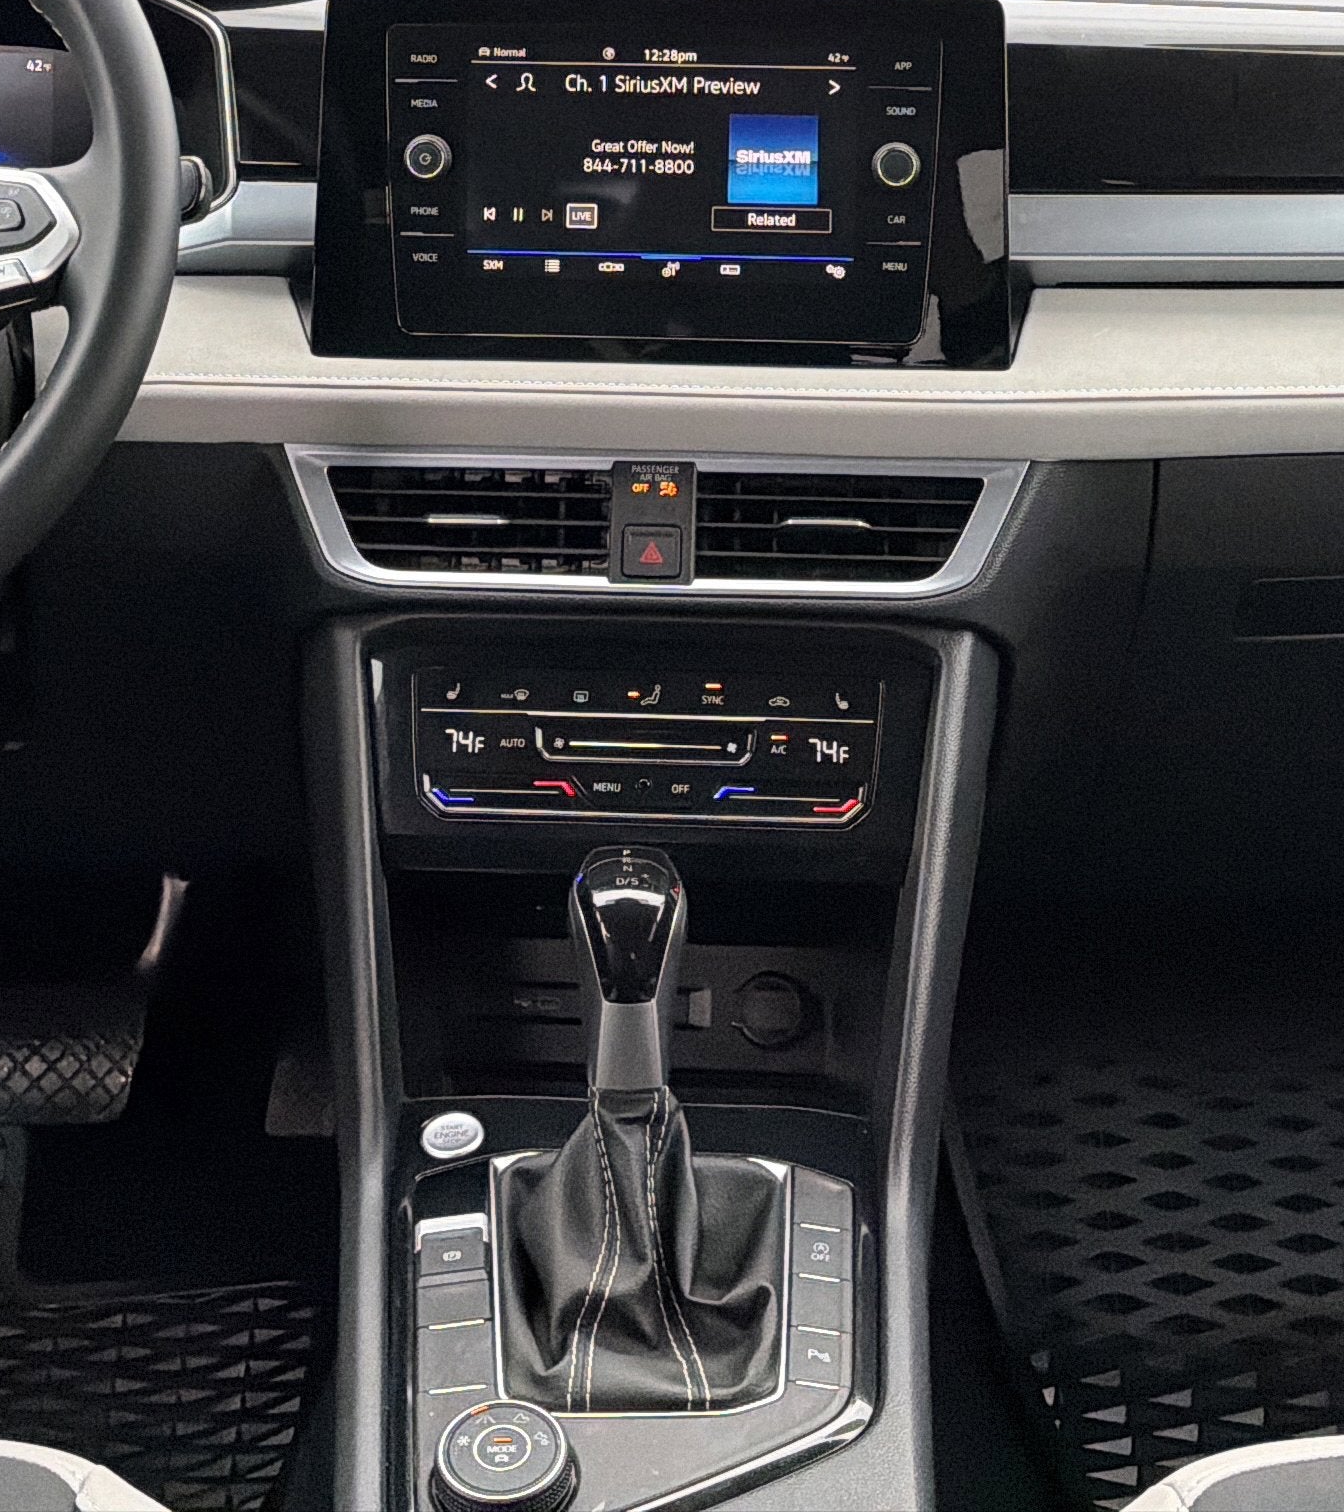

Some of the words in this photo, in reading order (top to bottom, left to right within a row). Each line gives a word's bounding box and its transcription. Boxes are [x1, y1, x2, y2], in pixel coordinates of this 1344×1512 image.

[493, 47, 527, 58] Normal
[643, 49, 698, 64] 12:28pm
[410, 54, 438, 63] RADIO
[894, 61, 913, 71] APP
[565, 74, 593, 92] Ch.
[599, 75, 607, 92] 1
[614, 75, 688, 94] SiriusXM
[693, 76, 761, 95] Preview
[410, 98, 439, 108] MEDIA
[885, 106, 917, 116] SOUND
[591, 139, 625, 153] Great
[627, 139, 659, 153] Offer
[661, 140, 695, 154] Now!
[735, 149, 811, 165] SiriusXM
[583, 158, 695, 174] 844-711-8800
[410, 206, 439, 216] PHONE
[571, 210, 593, 222] LIVE
[747, 213, 796, 227] Related
[887, 215, 906, 225] CAR
[412, 252, 439, 263] VOICE
[483, 259, 504, 271] SXM
[882, 261, 908, 272] MENU
[631, 465, 680, 474] PASSENGER
[639, 474, 653, 482] AIR
[654, 474, 672, 482] BAG
[631, 482, 651, 493] OFF
[701, 695, 725, 705] SYNC
[499, 738, 526, 748] AUTO
[770, 744, 787, 754] A/C
[593, 782, 622, 793] MENU
[671, 783, 691, 794] OFF
[616, 877, 639, 886] D/S
[810, 1253, 831, 1263] OFF
[487, 1444, 517, 1454] MODE
